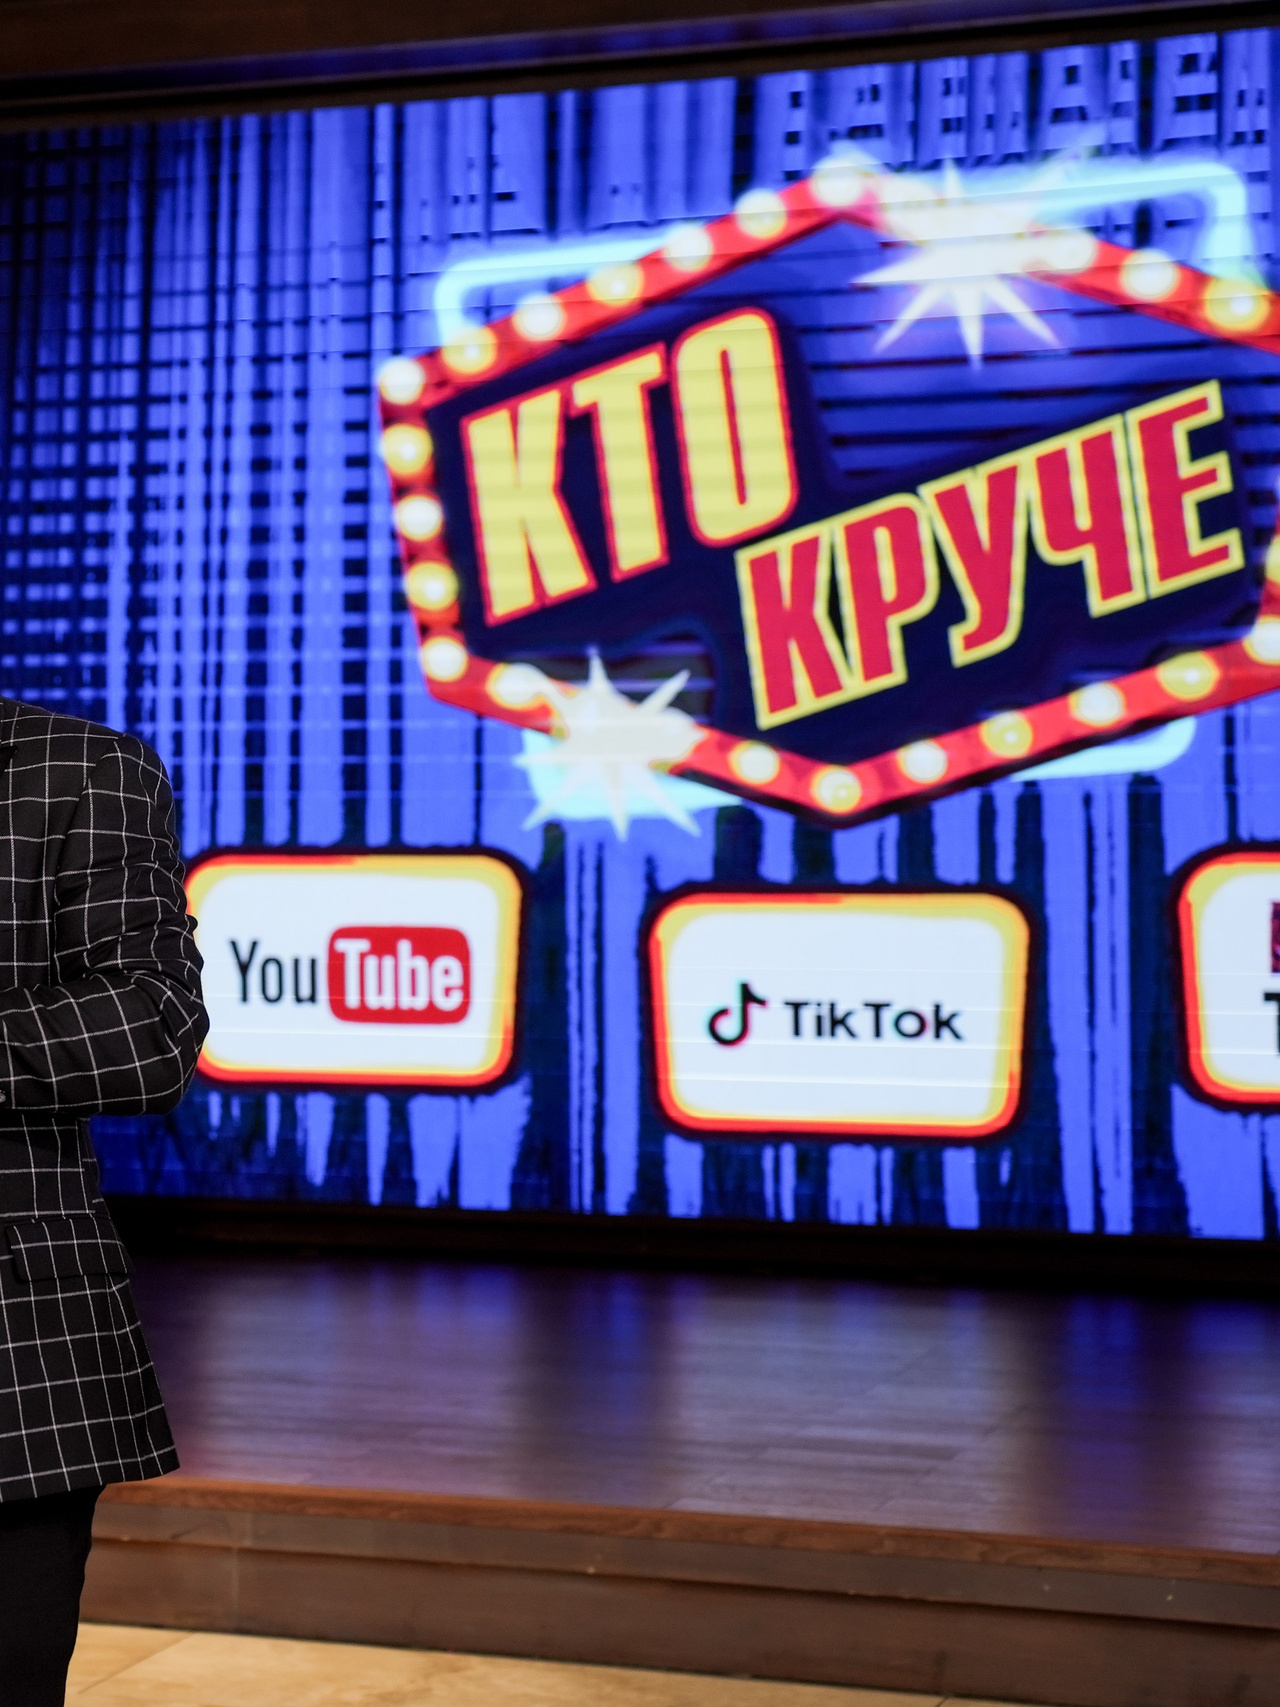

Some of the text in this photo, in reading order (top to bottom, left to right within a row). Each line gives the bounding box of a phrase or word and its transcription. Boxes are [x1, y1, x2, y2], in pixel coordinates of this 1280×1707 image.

[461, 307, 798, 626] КТО
[735, 379, 1245, 730] КРУЧЕ
[783, 1001, 963, 1040] TikTok
